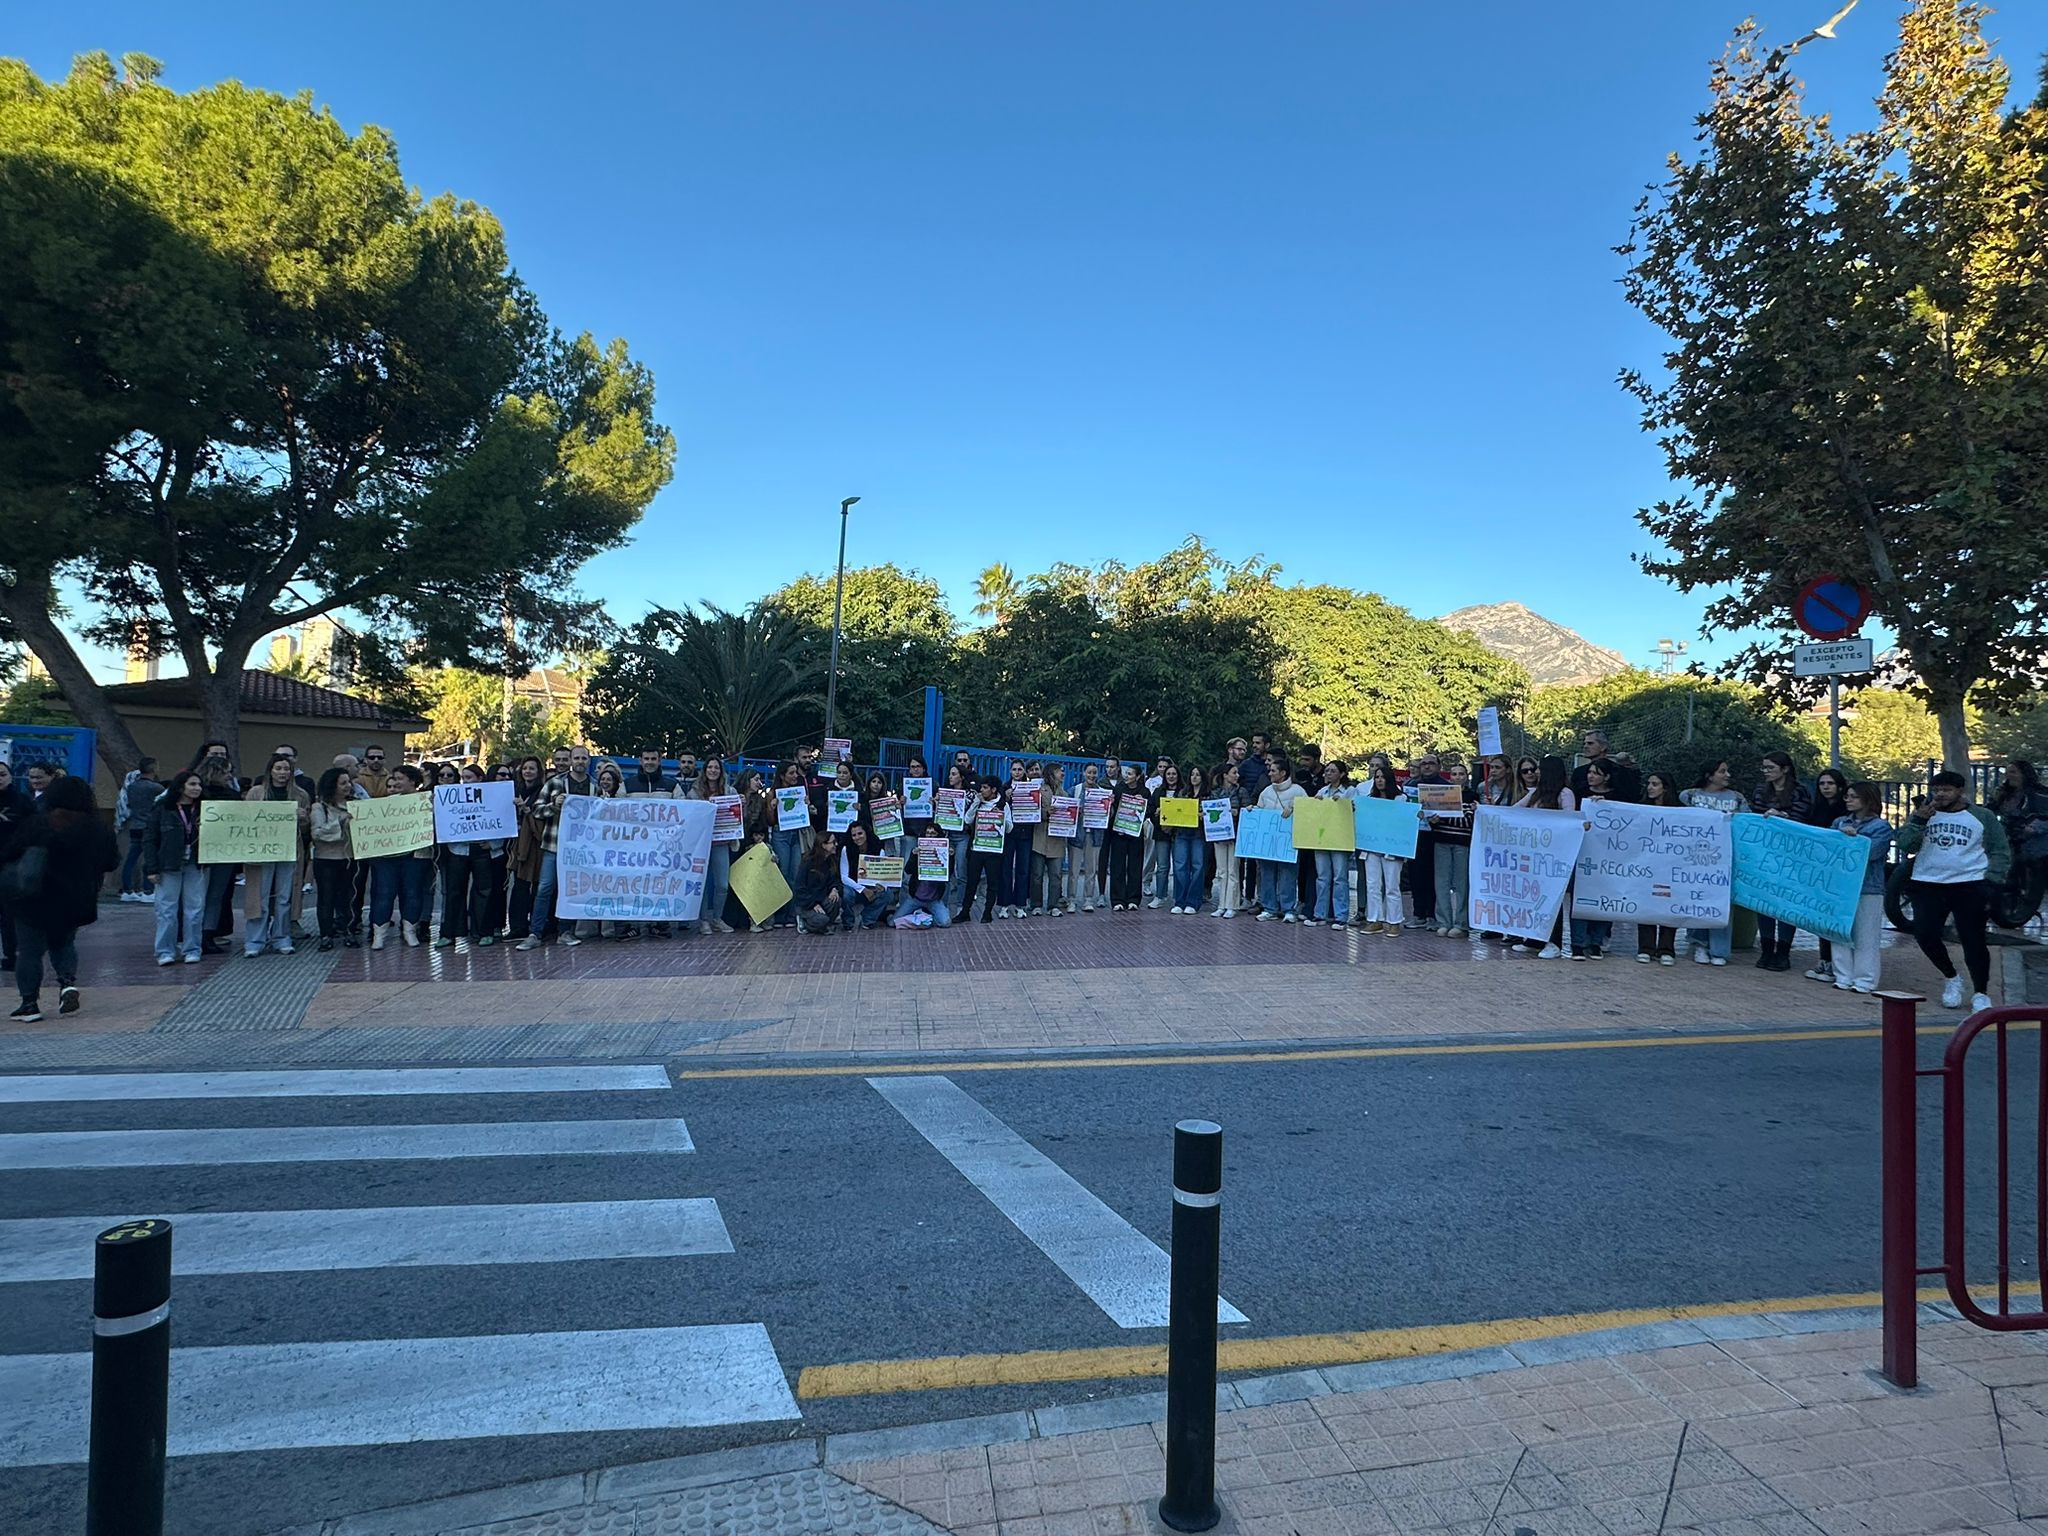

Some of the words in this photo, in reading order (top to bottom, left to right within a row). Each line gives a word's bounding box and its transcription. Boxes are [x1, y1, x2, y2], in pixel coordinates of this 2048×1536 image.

[1803, 652, 1863, 662] RESIDENTES
[1811, 645, 1854, 654] EXCEPTO
[437, 786, 483, 806] VOLEM
[355, 804, 375, 821] LA
[450, 805, 491, 815] educar
[566, 824, 595, 842] NO
[602, 825, 649, 841] PULPO
[1594, 809, 1633, 833] SOY
[1650, 817, 1720, 840] MAESTRA
[356, 839, 369, 854] NO
[1607, 834, 1629, 851] NO
[1638, 837, 1684, 855] PULPO
[604, 850, 692, 872] RECURSOS
[1484, 846, 1517, 871] PAÍS
[1600, 859, 1653, 878] RECURSOS
[1671, 867, 1730, 887] EDUCACIÓN
[1759, 851, 1840, 896] ESPECIAL
[565, 869, 682, 897] EDUCACIÓN
[685, 881, 702, 896] DE
[1600, 895, 1637, 914] RATIO
[1690, 890, 1705, 901] DE
[584, 895, 687, 918] CALIDAD
[1670, 903, 1722, 918] CALIDAD
